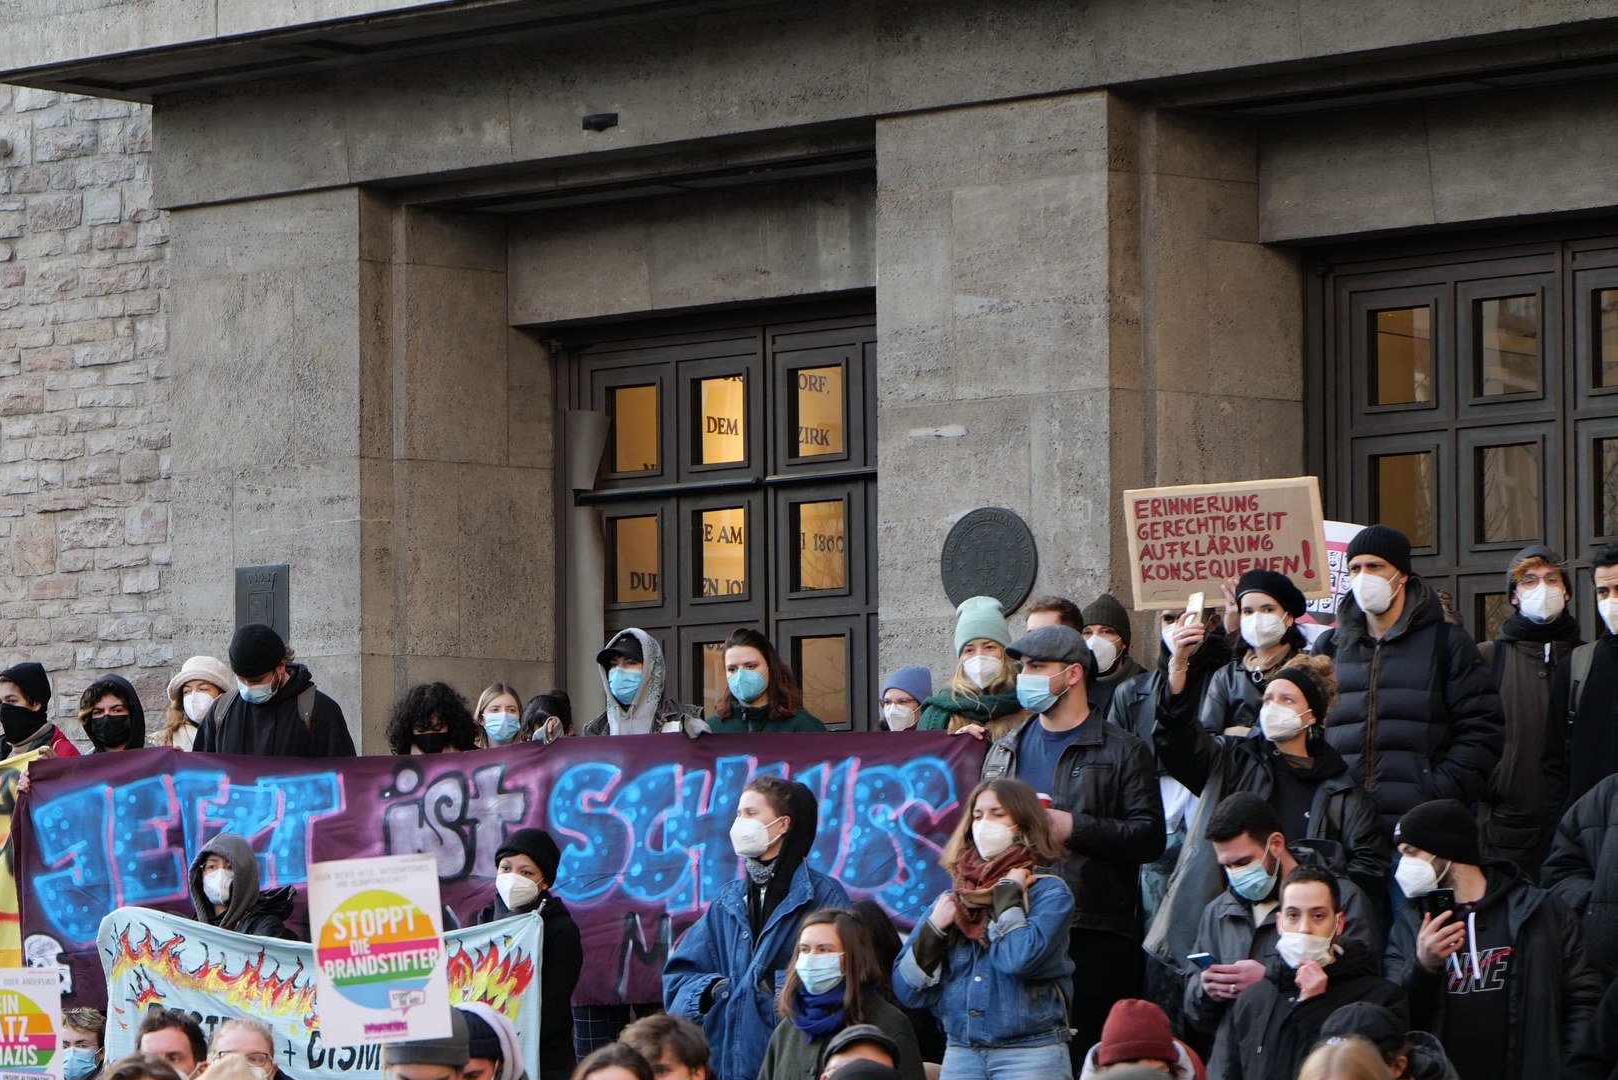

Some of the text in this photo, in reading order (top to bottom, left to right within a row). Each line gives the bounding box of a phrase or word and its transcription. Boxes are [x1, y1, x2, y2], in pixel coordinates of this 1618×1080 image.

[706, 415, 739, 436] DEM
[1135, 494, 1259, 519] ERINNERUNG
[1138, 511, 1289, 540] GERECHTIGKEIT
[1139, 534, 1275, 561] AUFKLÄRUNG
[332, 903, 416, 941] STOPPT
[349, 937, 371, 956] DIE
[323, 946, 441, 981] BRANDSTIFTER
